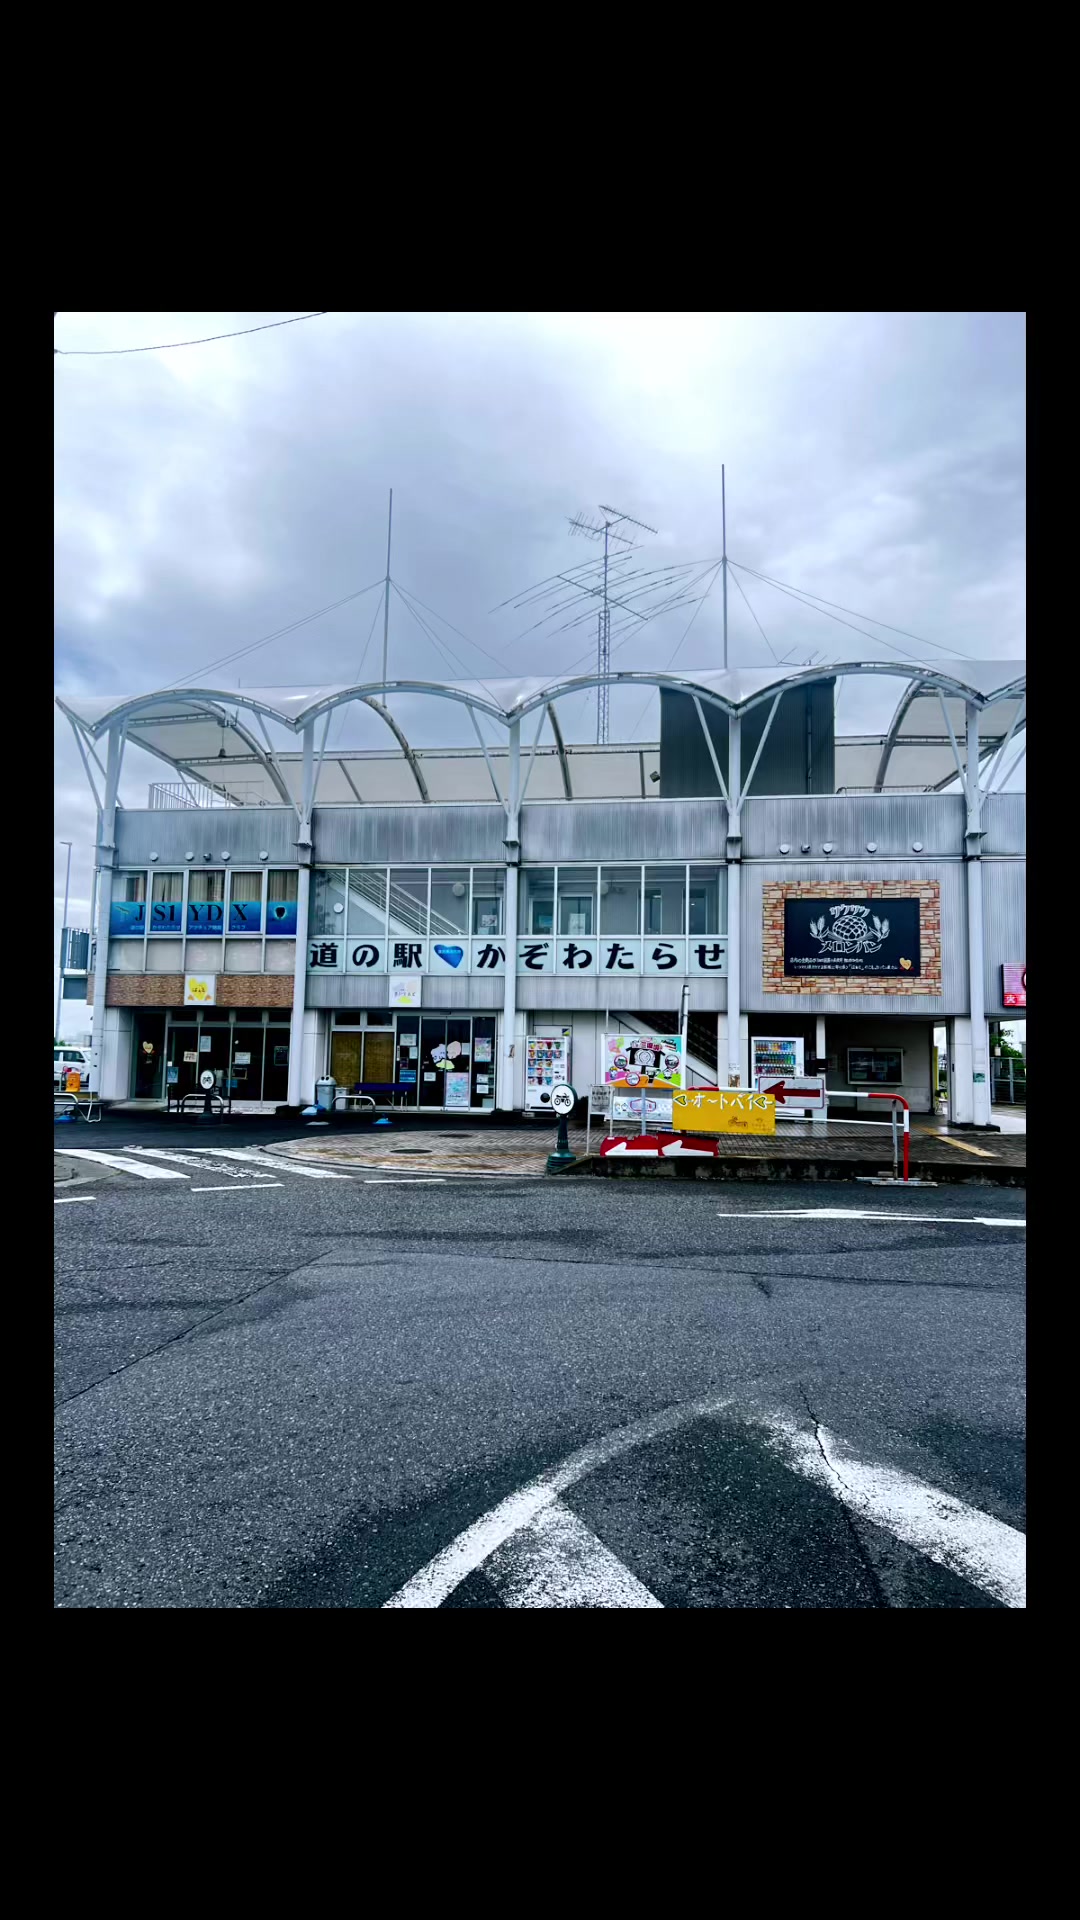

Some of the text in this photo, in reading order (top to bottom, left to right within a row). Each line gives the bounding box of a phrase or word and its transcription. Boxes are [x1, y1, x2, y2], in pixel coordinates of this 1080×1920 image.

[829, 904, 871, 919] サクサク
[818, 940, 882, 954] メロンパン
[310, 942, 725, 970] 道の駅 かぞわたらせ
